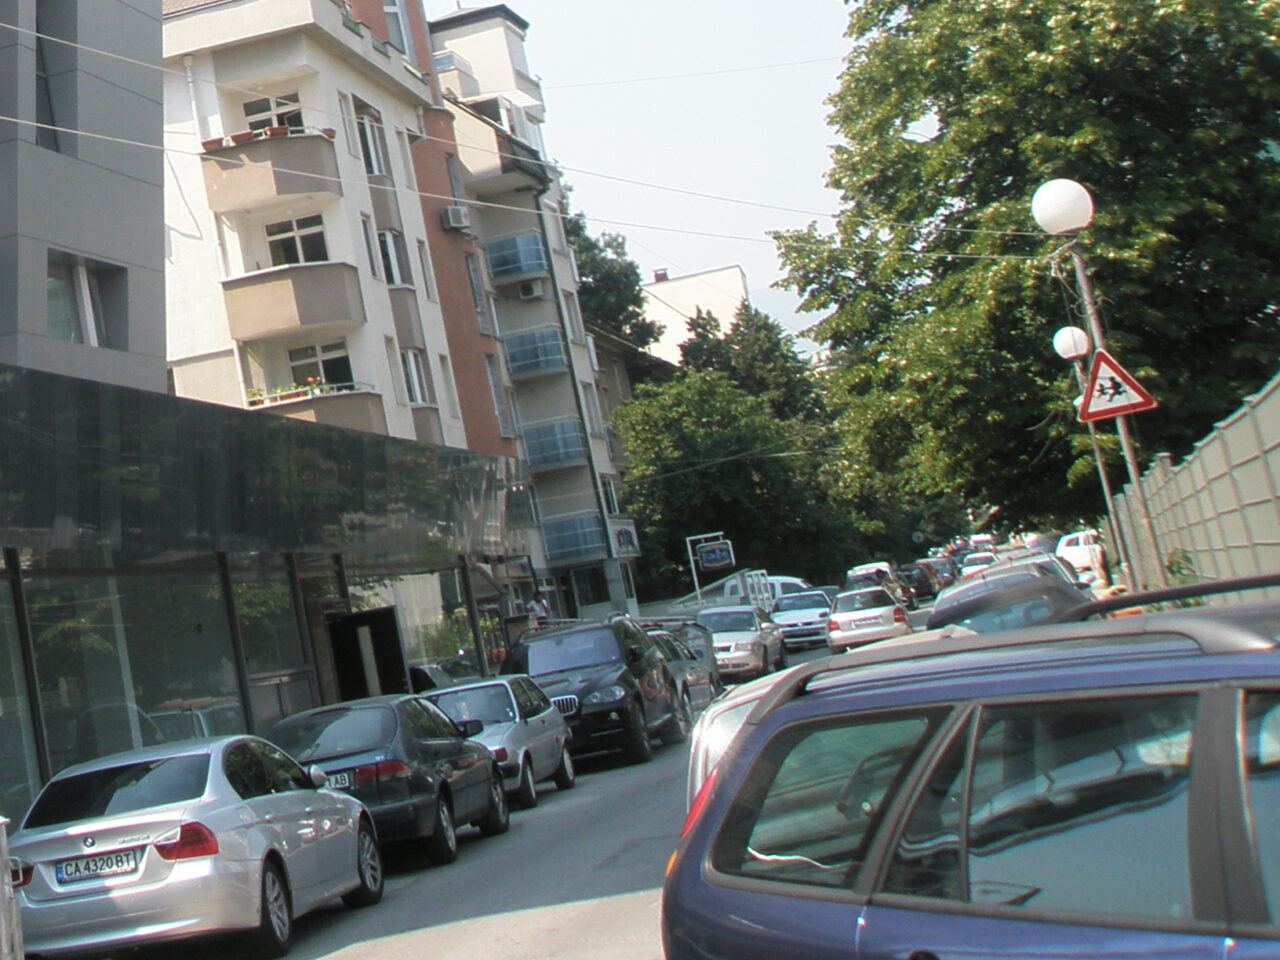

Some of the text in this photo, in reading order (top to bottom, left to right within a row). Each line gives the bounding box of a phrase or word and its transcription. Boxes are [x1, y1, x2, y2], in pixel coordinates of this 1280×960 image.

[64, 852, 132, 877] CA 4320 BT
